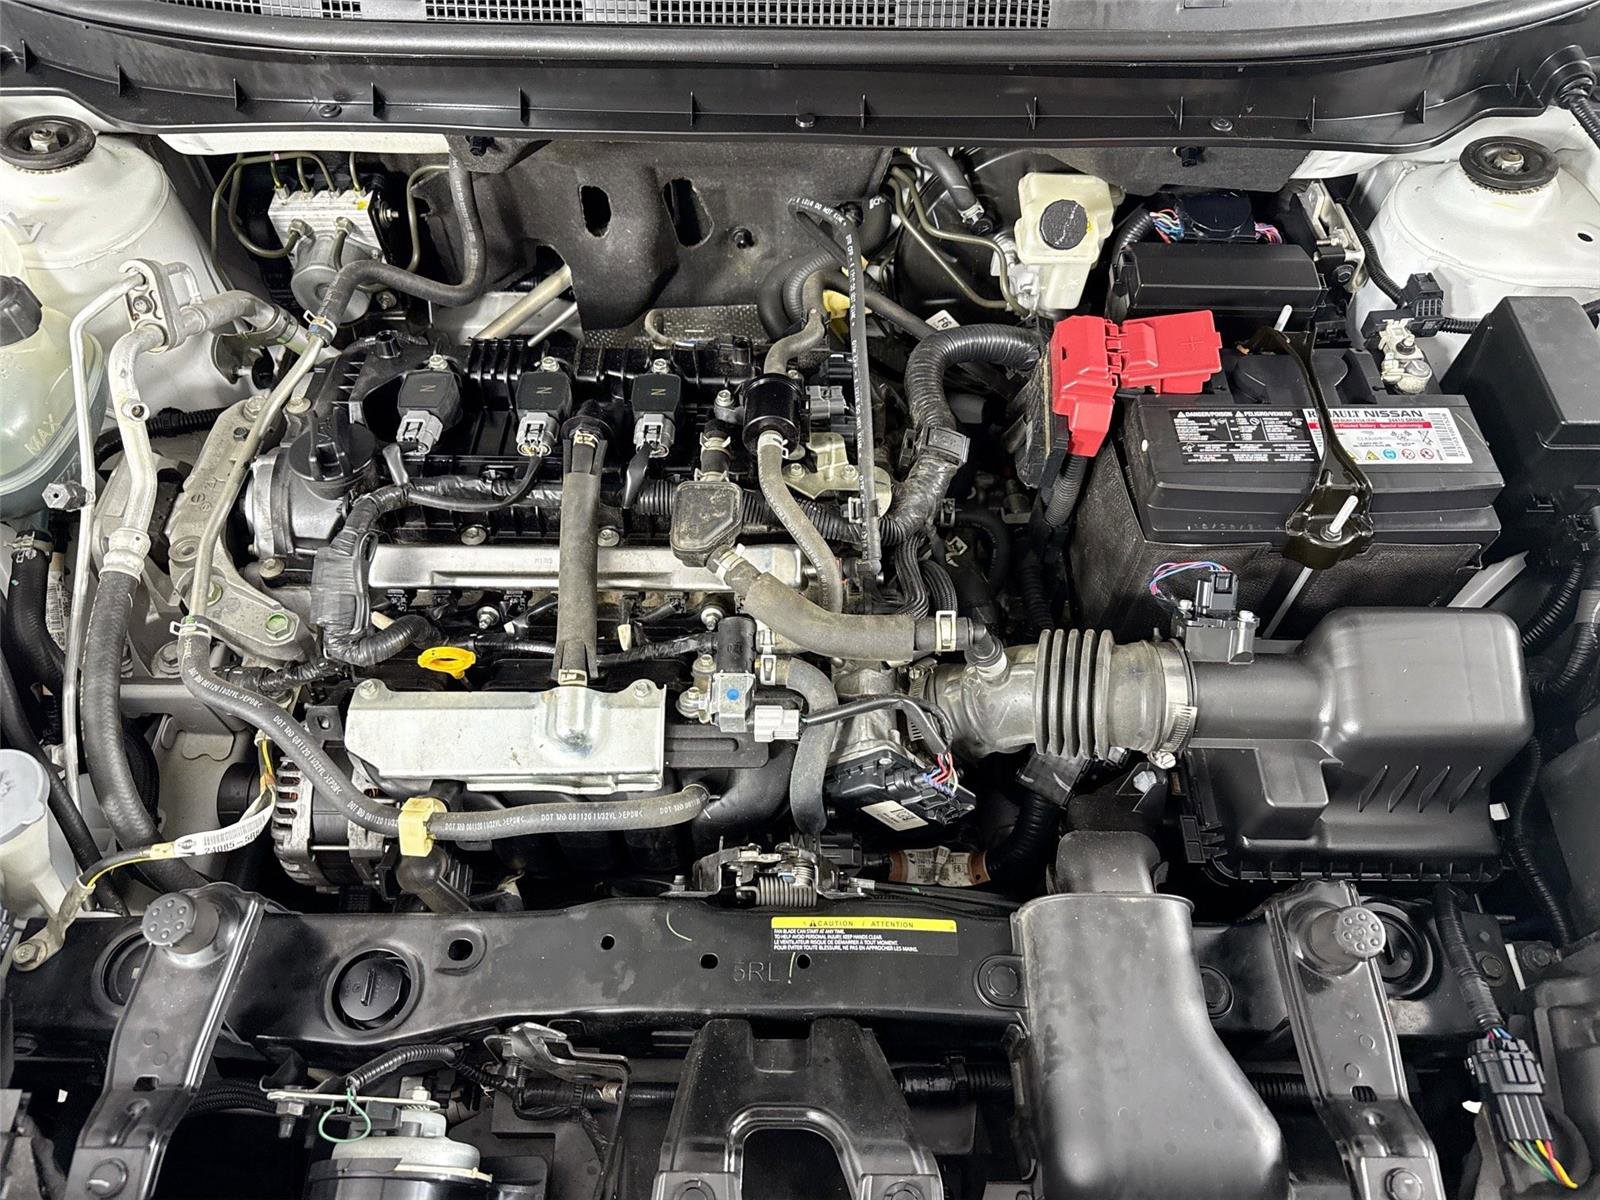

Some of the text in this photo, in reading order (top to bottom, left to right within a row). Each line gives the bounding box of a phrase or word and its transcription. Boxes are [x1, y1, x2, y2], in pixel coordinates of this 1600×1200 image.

[1307, 410, 1423, 418] RAULT NISSAN
[24, 413, 61, 456] MAX
[272, 714, 287, 729] DOT
[659, 806, 672, 815] DOT
[541, 813, 554, 822] DOT
[871, 921, 915, 929] ATTENTION
